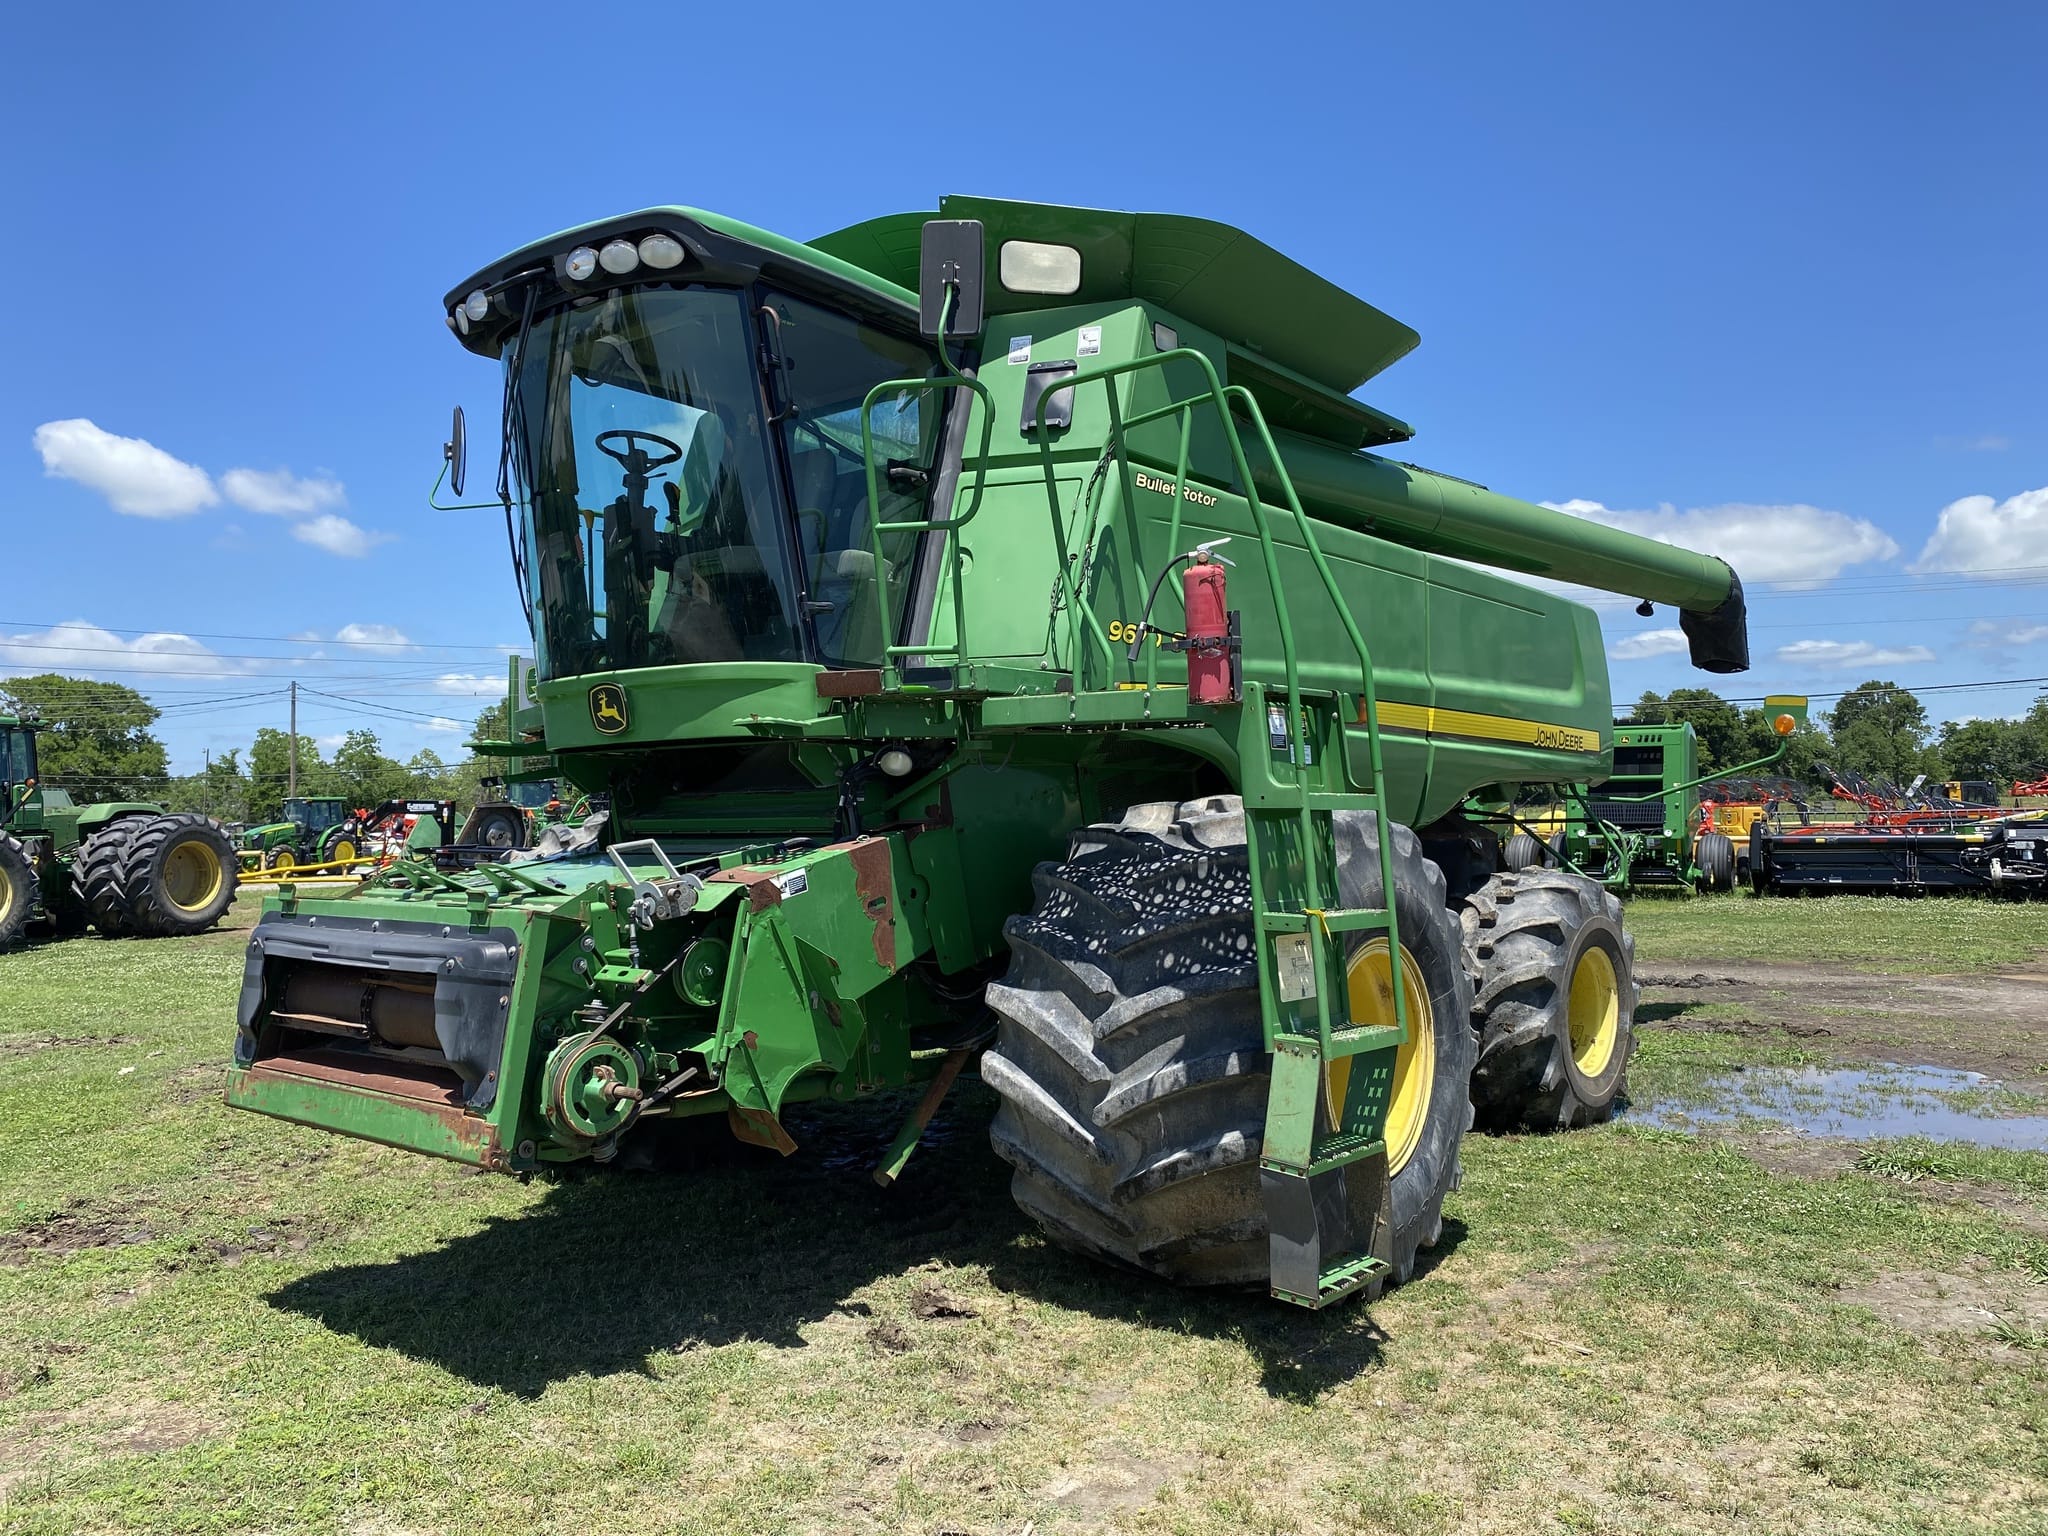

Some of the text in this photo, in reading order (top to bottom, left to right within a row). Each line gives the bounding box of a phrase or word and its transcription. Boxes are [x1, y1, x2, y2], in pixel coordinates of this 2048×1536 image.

[1135, 472, 1177, 497] Bullet
[1108, 620, 1163, 648] 96
[1534, 727, 1584, 751] JOHN DEERE
